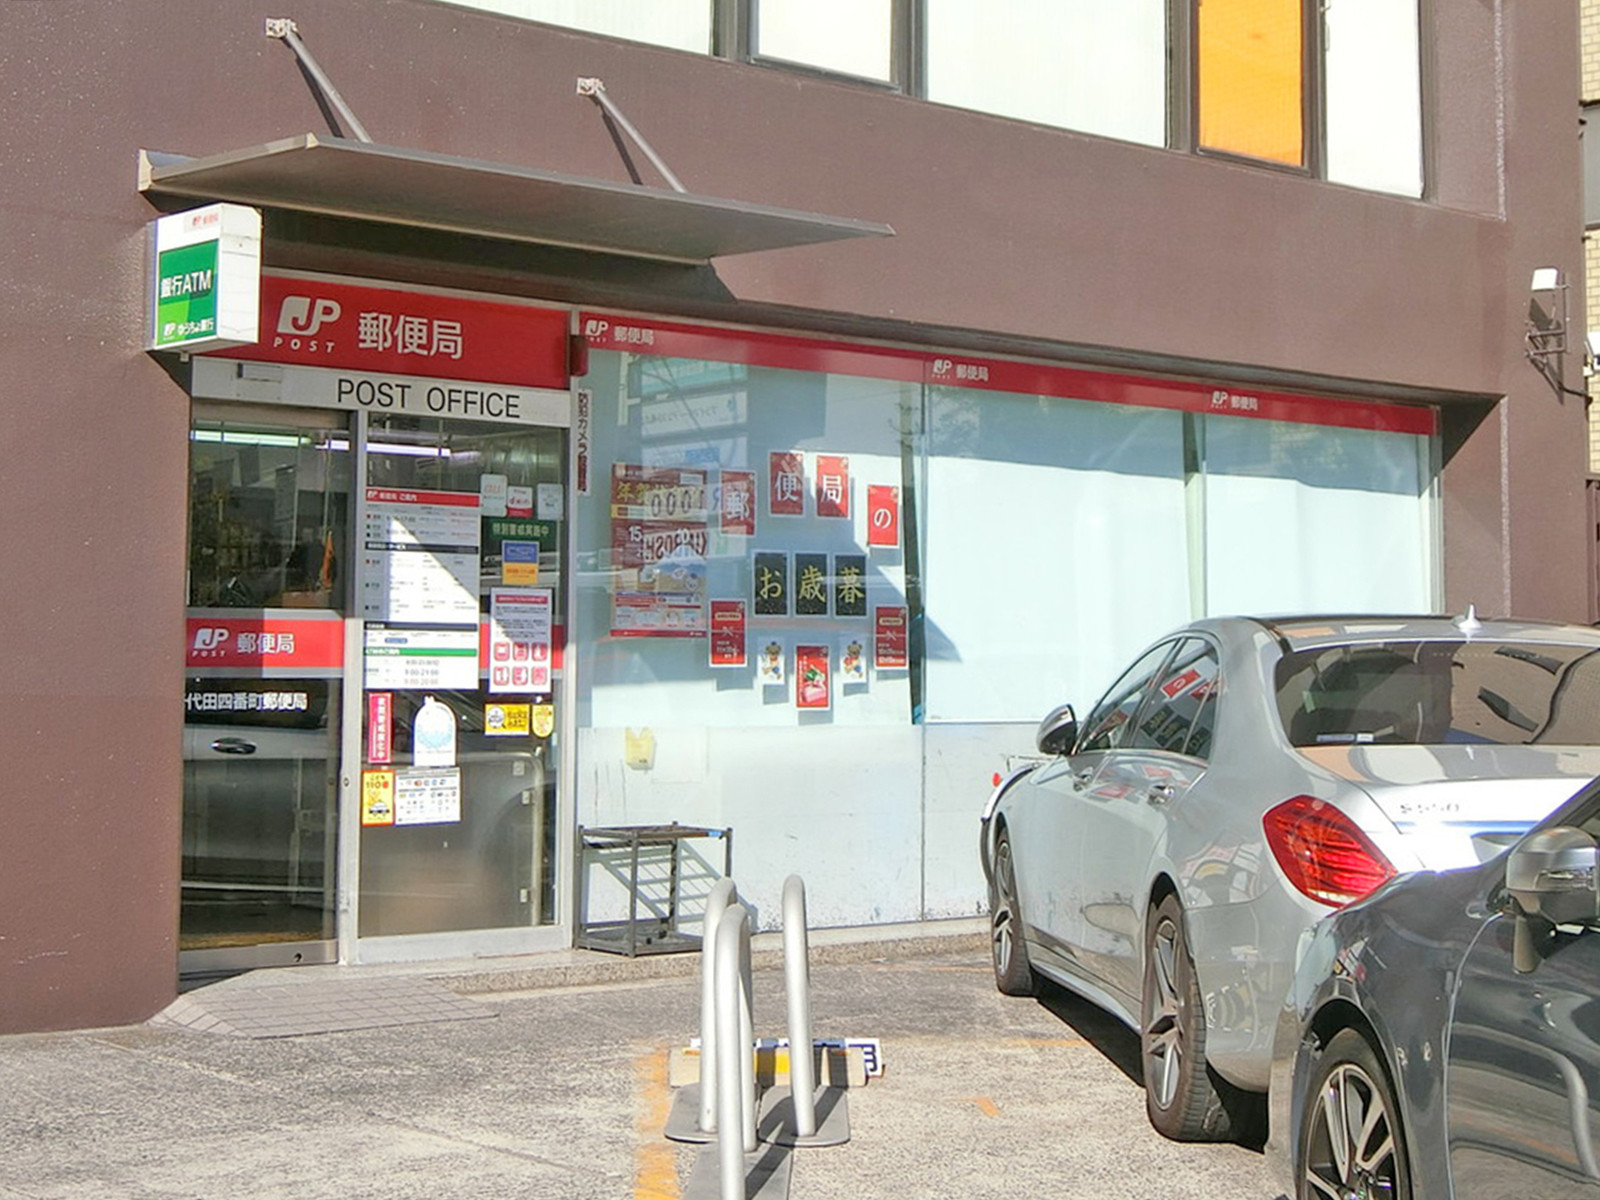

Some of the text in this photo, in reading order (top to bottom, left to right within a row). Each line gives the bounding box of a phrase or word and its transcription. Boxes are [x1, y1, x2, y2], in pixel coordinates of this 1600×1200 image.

[160, 269, 212, 299] 銀行ATM
[273, 337, 335, 354] POST
[358, 312, 463, 359] 郵便局
[614, 325, 654, 346] 郵便局
[956, 364, 989, 382] 郵便局
[337, 378, 520, 419] POST OFFICE
[760, 565, 864, 603] お歳暮
[237, 633, 295, 654] 郵便局
[184, 692, 308, 711] 代田四番町郵便局
